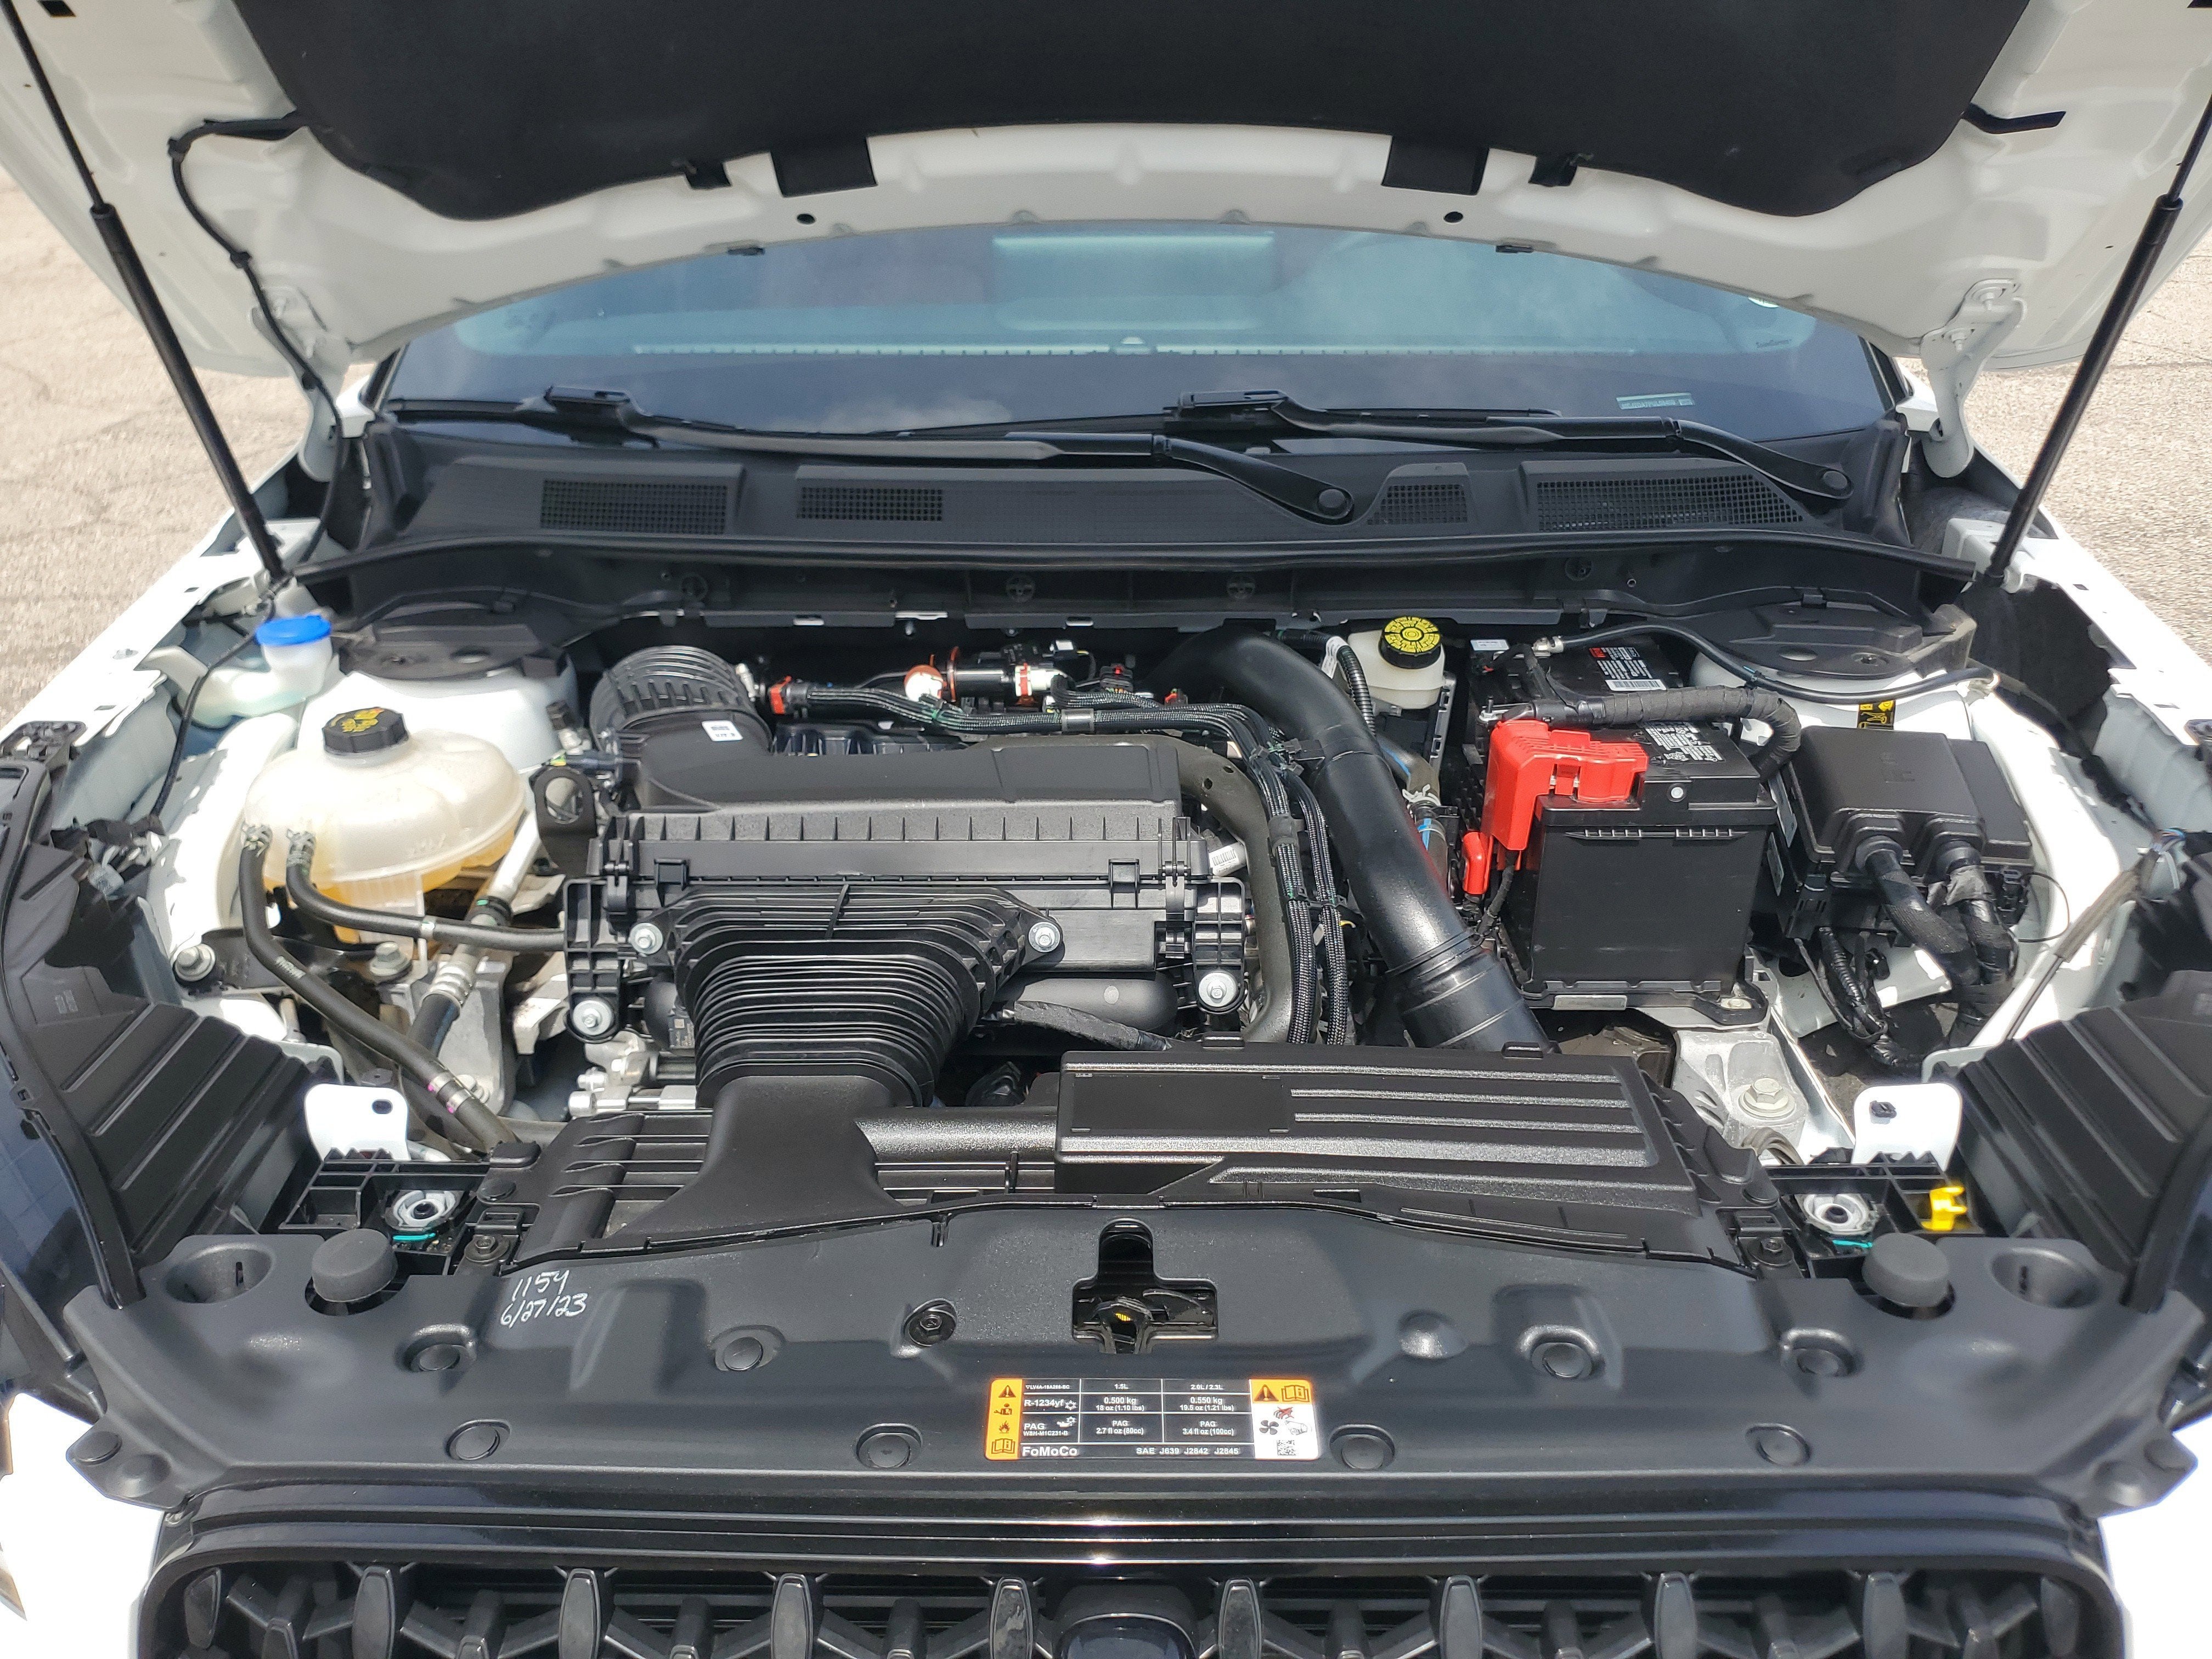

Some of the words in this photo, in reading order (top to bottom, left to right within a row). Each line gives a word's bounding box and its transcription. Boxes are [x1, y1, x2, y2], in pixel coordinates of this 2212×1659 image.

[1024, 1399, 1064, 1408] R-1234yf
[1126, 1397, 1136, 1405] kg
[1212, 1397, 1223, 1405] kg
[1022, 1446, 1077, 1457] FoMoCo
